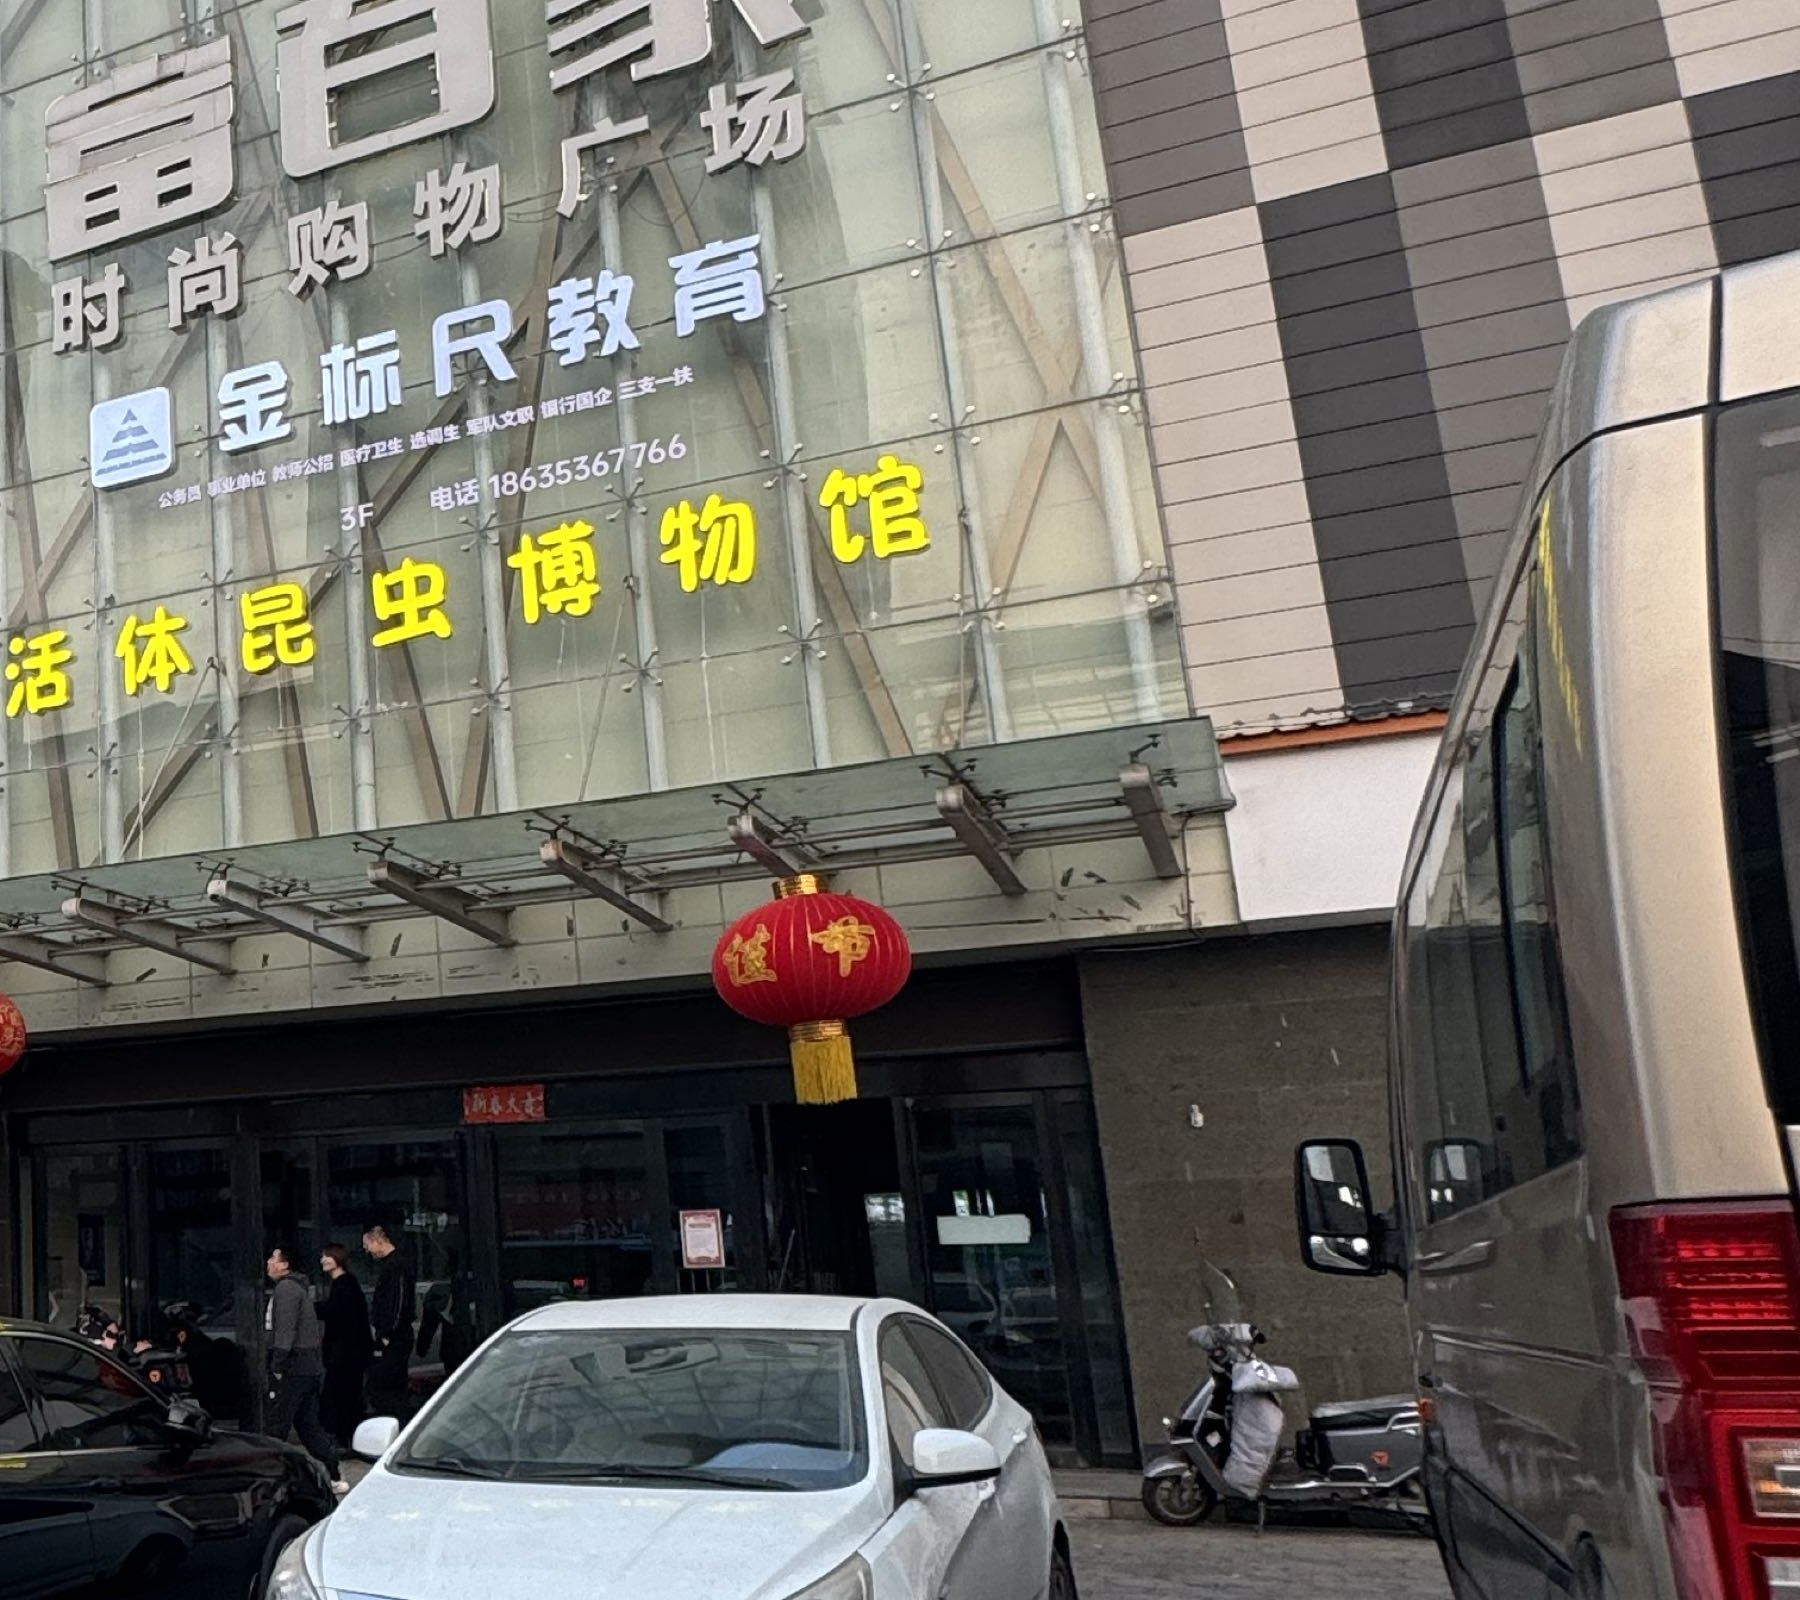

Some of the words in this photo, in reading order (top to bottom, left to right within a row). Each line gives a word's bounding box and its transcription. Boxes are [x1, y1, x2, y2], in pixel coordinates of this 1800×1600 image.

[50, 69, 806, 354] 时尚购物广场
[158, 485, 202, 508] 公务员
[207, 469, 266, 498] 事业单位
[340, 436, 404, 468] 医疗卫生
[410, 423, 461, 450] 选调生
[466, 405, 535, 436] 军队文职
[540, 387, 612, 419] 银行国企
[618, 365, 693, 399] 三支一扶
[340, 502, 374, 531] 3F
[430, 478, 480, 511] 电话
[488, 433, 687, 499] 18635367766
[3, 455, 933, 720] 活体昆虫博物馆
